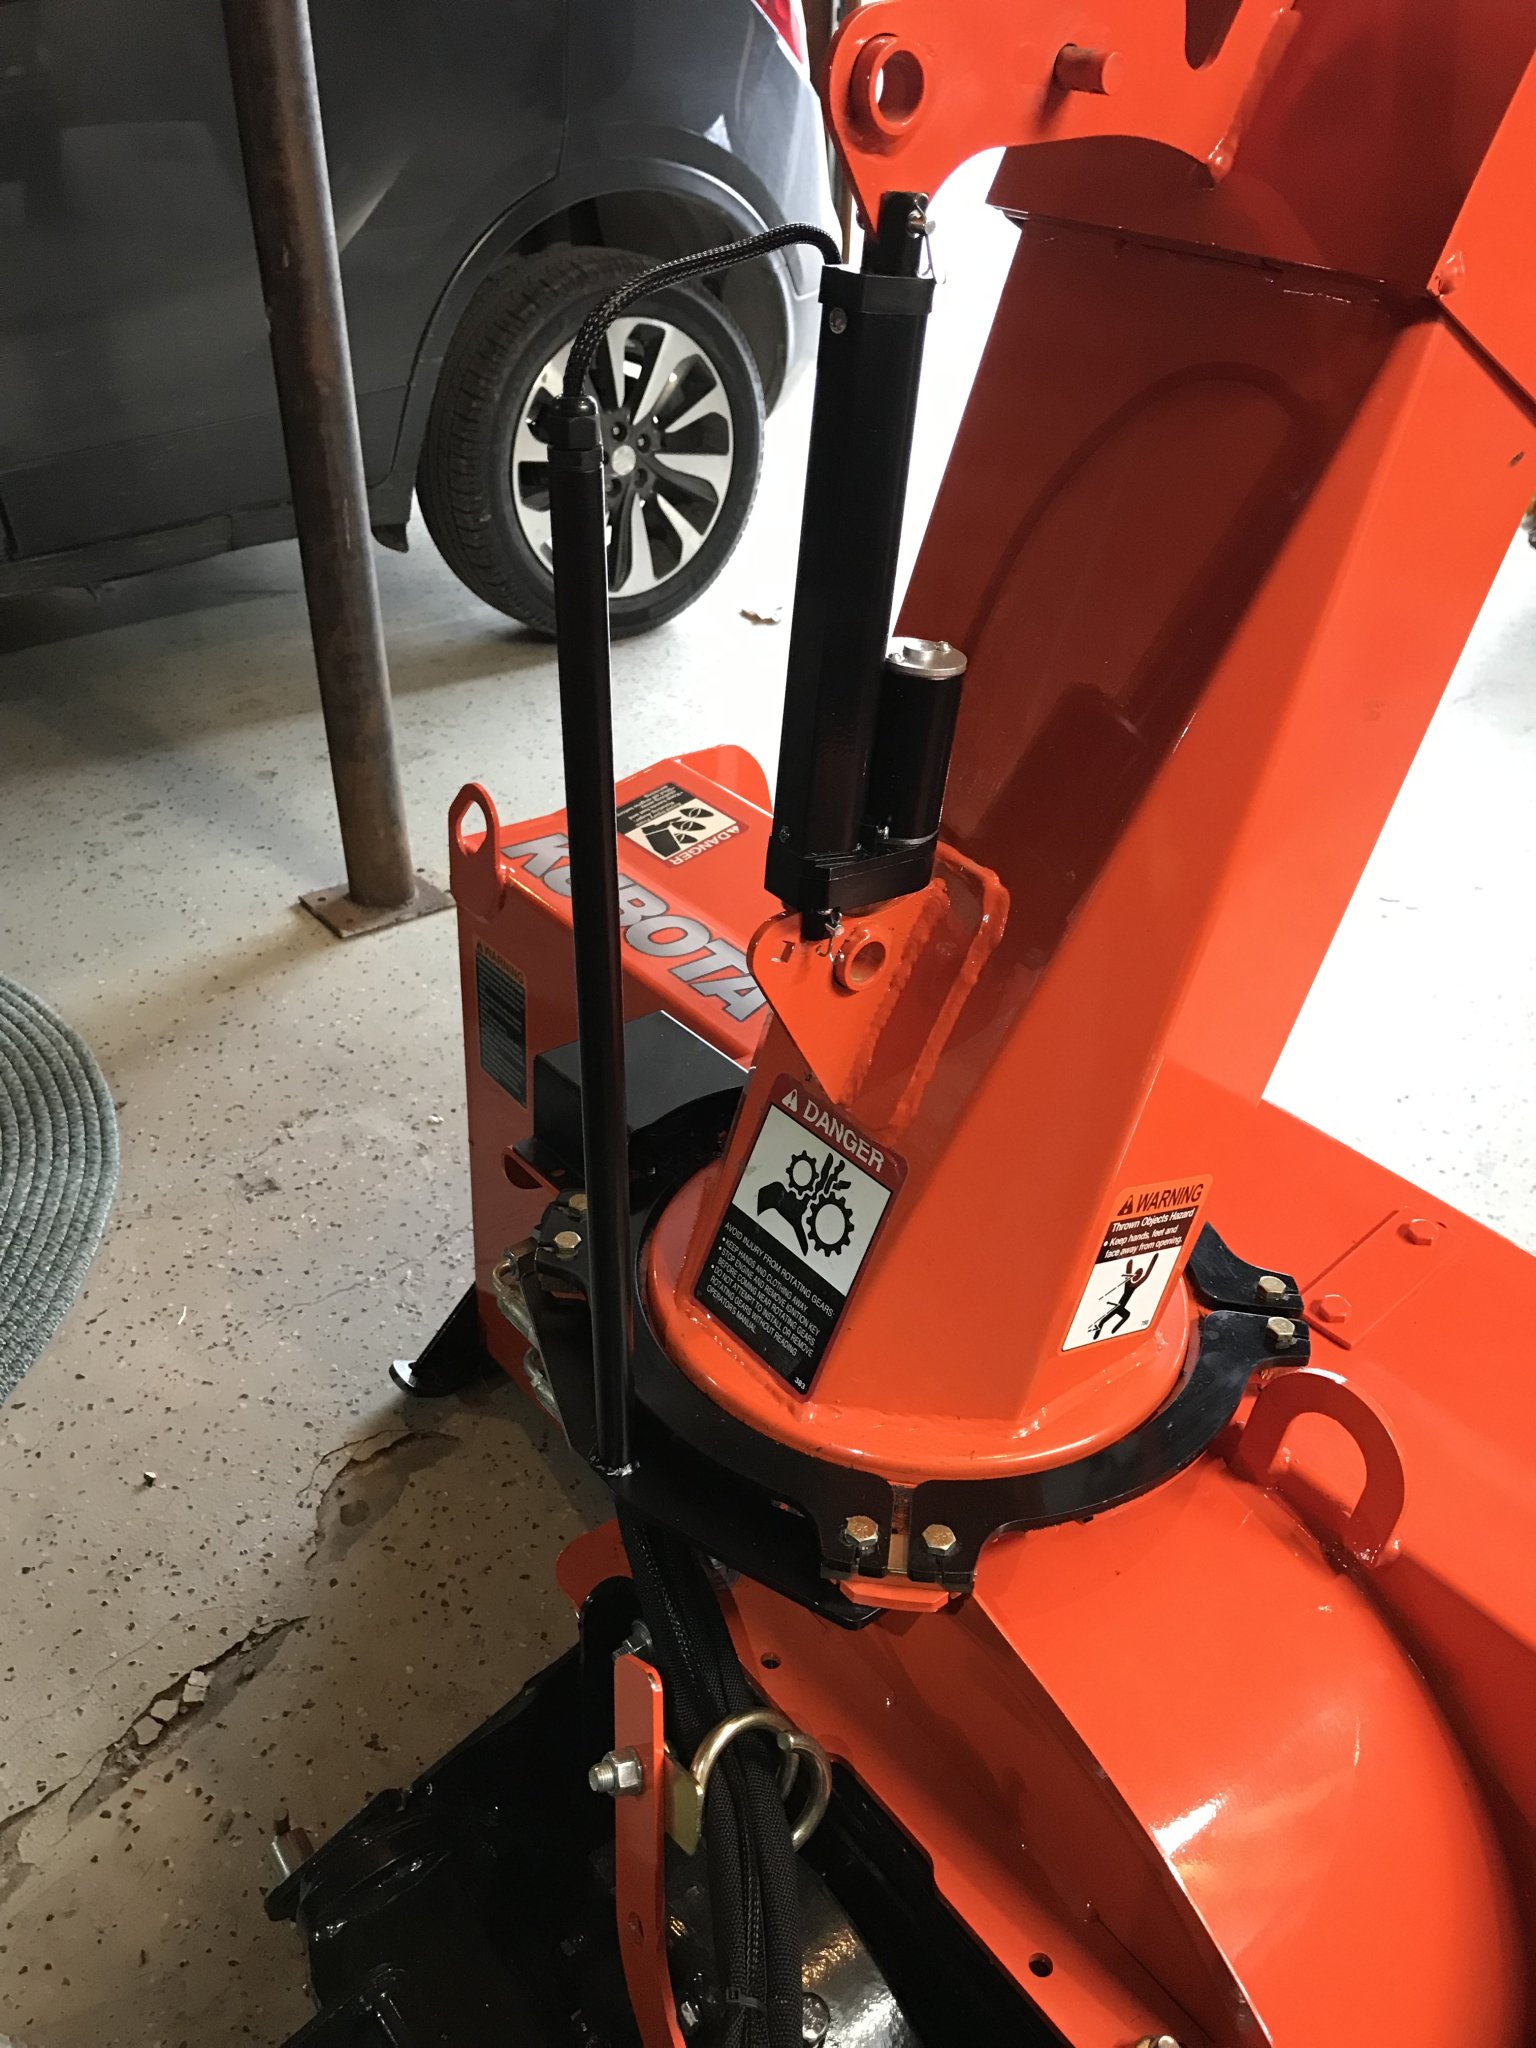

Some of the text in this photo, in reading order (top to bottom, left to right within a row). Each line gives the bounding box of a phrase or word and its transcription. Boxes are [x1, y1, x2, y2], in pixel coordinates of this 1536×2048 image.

[669, 831, 731, 865] DANGER
[803, 1099, 884, 1173] DANGER
[1112, 1208, 1195, 1232] Thrown Objects Hazard
[1136, 1184, 1203, 1213] WARNING
[725, 1222, 743, 1240] AVOID
[742, 1236, 764, 1257] INJURY
[763, 1253, 781, 1272] FROM
[780, 1268, 811, 1298] ROTATING
[1105, 1249, 1120, 1258] face
[1120, 1245, 1139, 1255] away
[1139, 1242, 1155, 1251] from
[1109, 1237, 1128, 1246] Keep
[1151, 1228, 1165, 1237] feet
[1164, 1225, 1179, 1235] and
[717, 1257, 738, 1278] BEFORE
[737, 1274, 758, 1295] COMING
[757, 1291, 772, 1307] NEAR
[771, 1303, 797, 1330] ROTATING
[721, 1248, 820, 1336] STOP ENGINE AND REMOVE IGNITION KEY
[726, 1239, 739, 1252] KEEP
[738, 1250, 756, 1268] HANDS
[755, 1265, 767, 1277] AND
[766, 1274, 792, 1299] CLOTHING
[710, 1275, 797, 1356] ROTATING GEARS WITHOUT READING
[714, 1266, 814, 1357] DO NOT ATTEMPT TO INSTALL OR REMOVE
